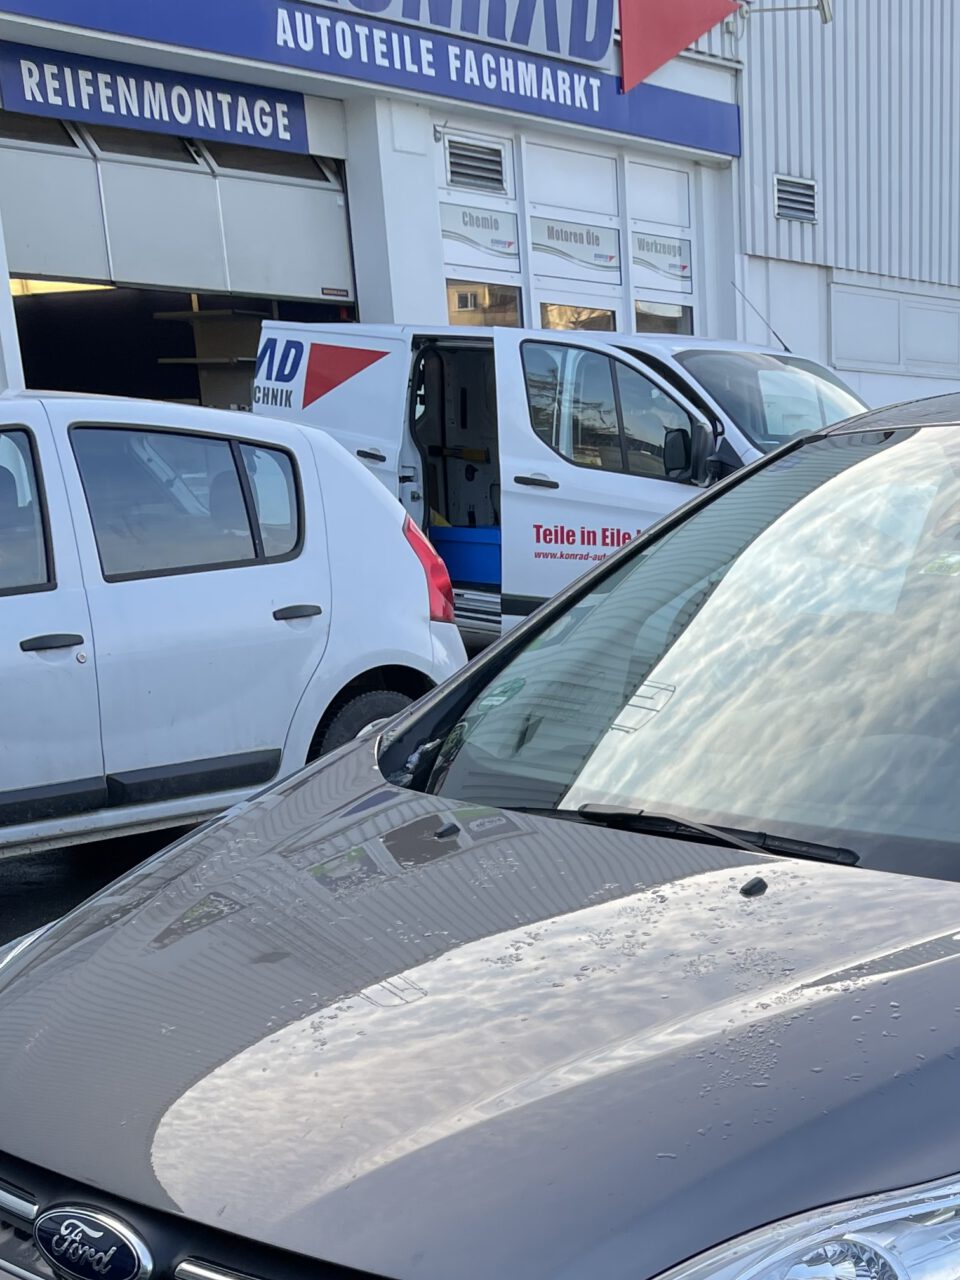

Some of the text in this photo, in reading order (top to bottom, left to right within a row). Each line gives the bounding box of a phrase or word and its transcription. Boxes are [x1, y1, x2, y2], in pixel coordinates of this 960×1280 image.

[276, 9, 601, 112] AUTOTEILE FACHMARKT
[20, 59, 291, 141] REIFENMONTAGE
[462, 211, 500, 231] Chemie
[547, 225, 601, 247] Motoren Öle
[637, 237, 682, 258] Werkzeuge
[533, 524, 632, 547] Teile in Eile
[52, 1219, 117, 1274] Ford
